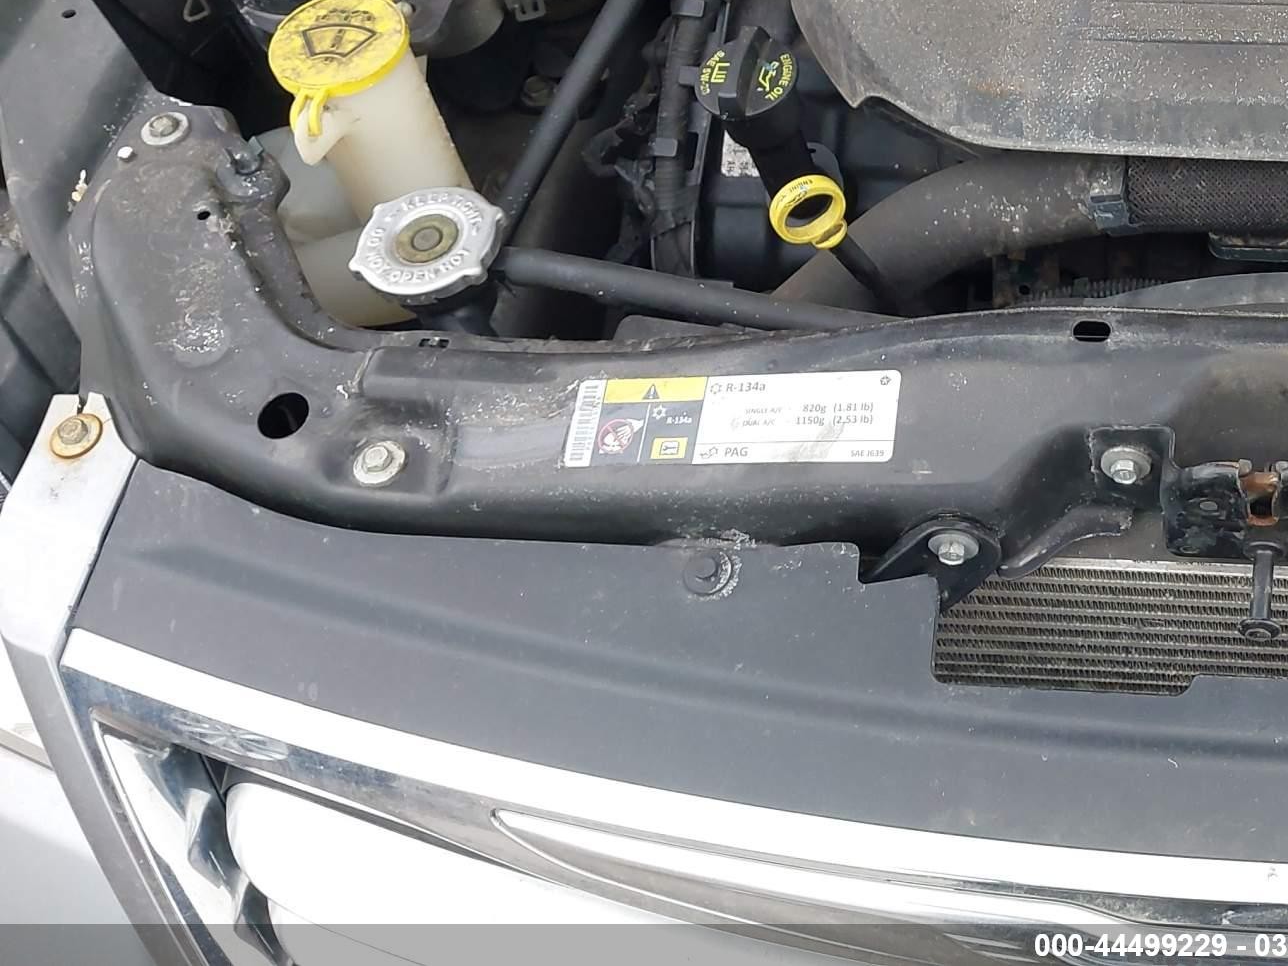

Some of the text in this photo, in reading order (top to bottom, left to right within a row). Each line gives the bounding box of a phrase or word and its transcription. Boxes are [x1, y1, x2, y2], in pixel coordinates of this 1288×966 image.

[764, 54, 792, 102] ENGINE OIL
[726, 382, 766, 392] R-134a
[802, 403, 826, 414] 820g
[833, 402, 858, 412] (1.81
[861, 402, 874, 412] lb)
[666, 416, 692, 424] R-134a
[796, 416, 824, 426] 1150g
[832, 415, 858, 424] (2.53
[860, 414, 873, 424] lb)
[724, 446, 748, 457] PAG
